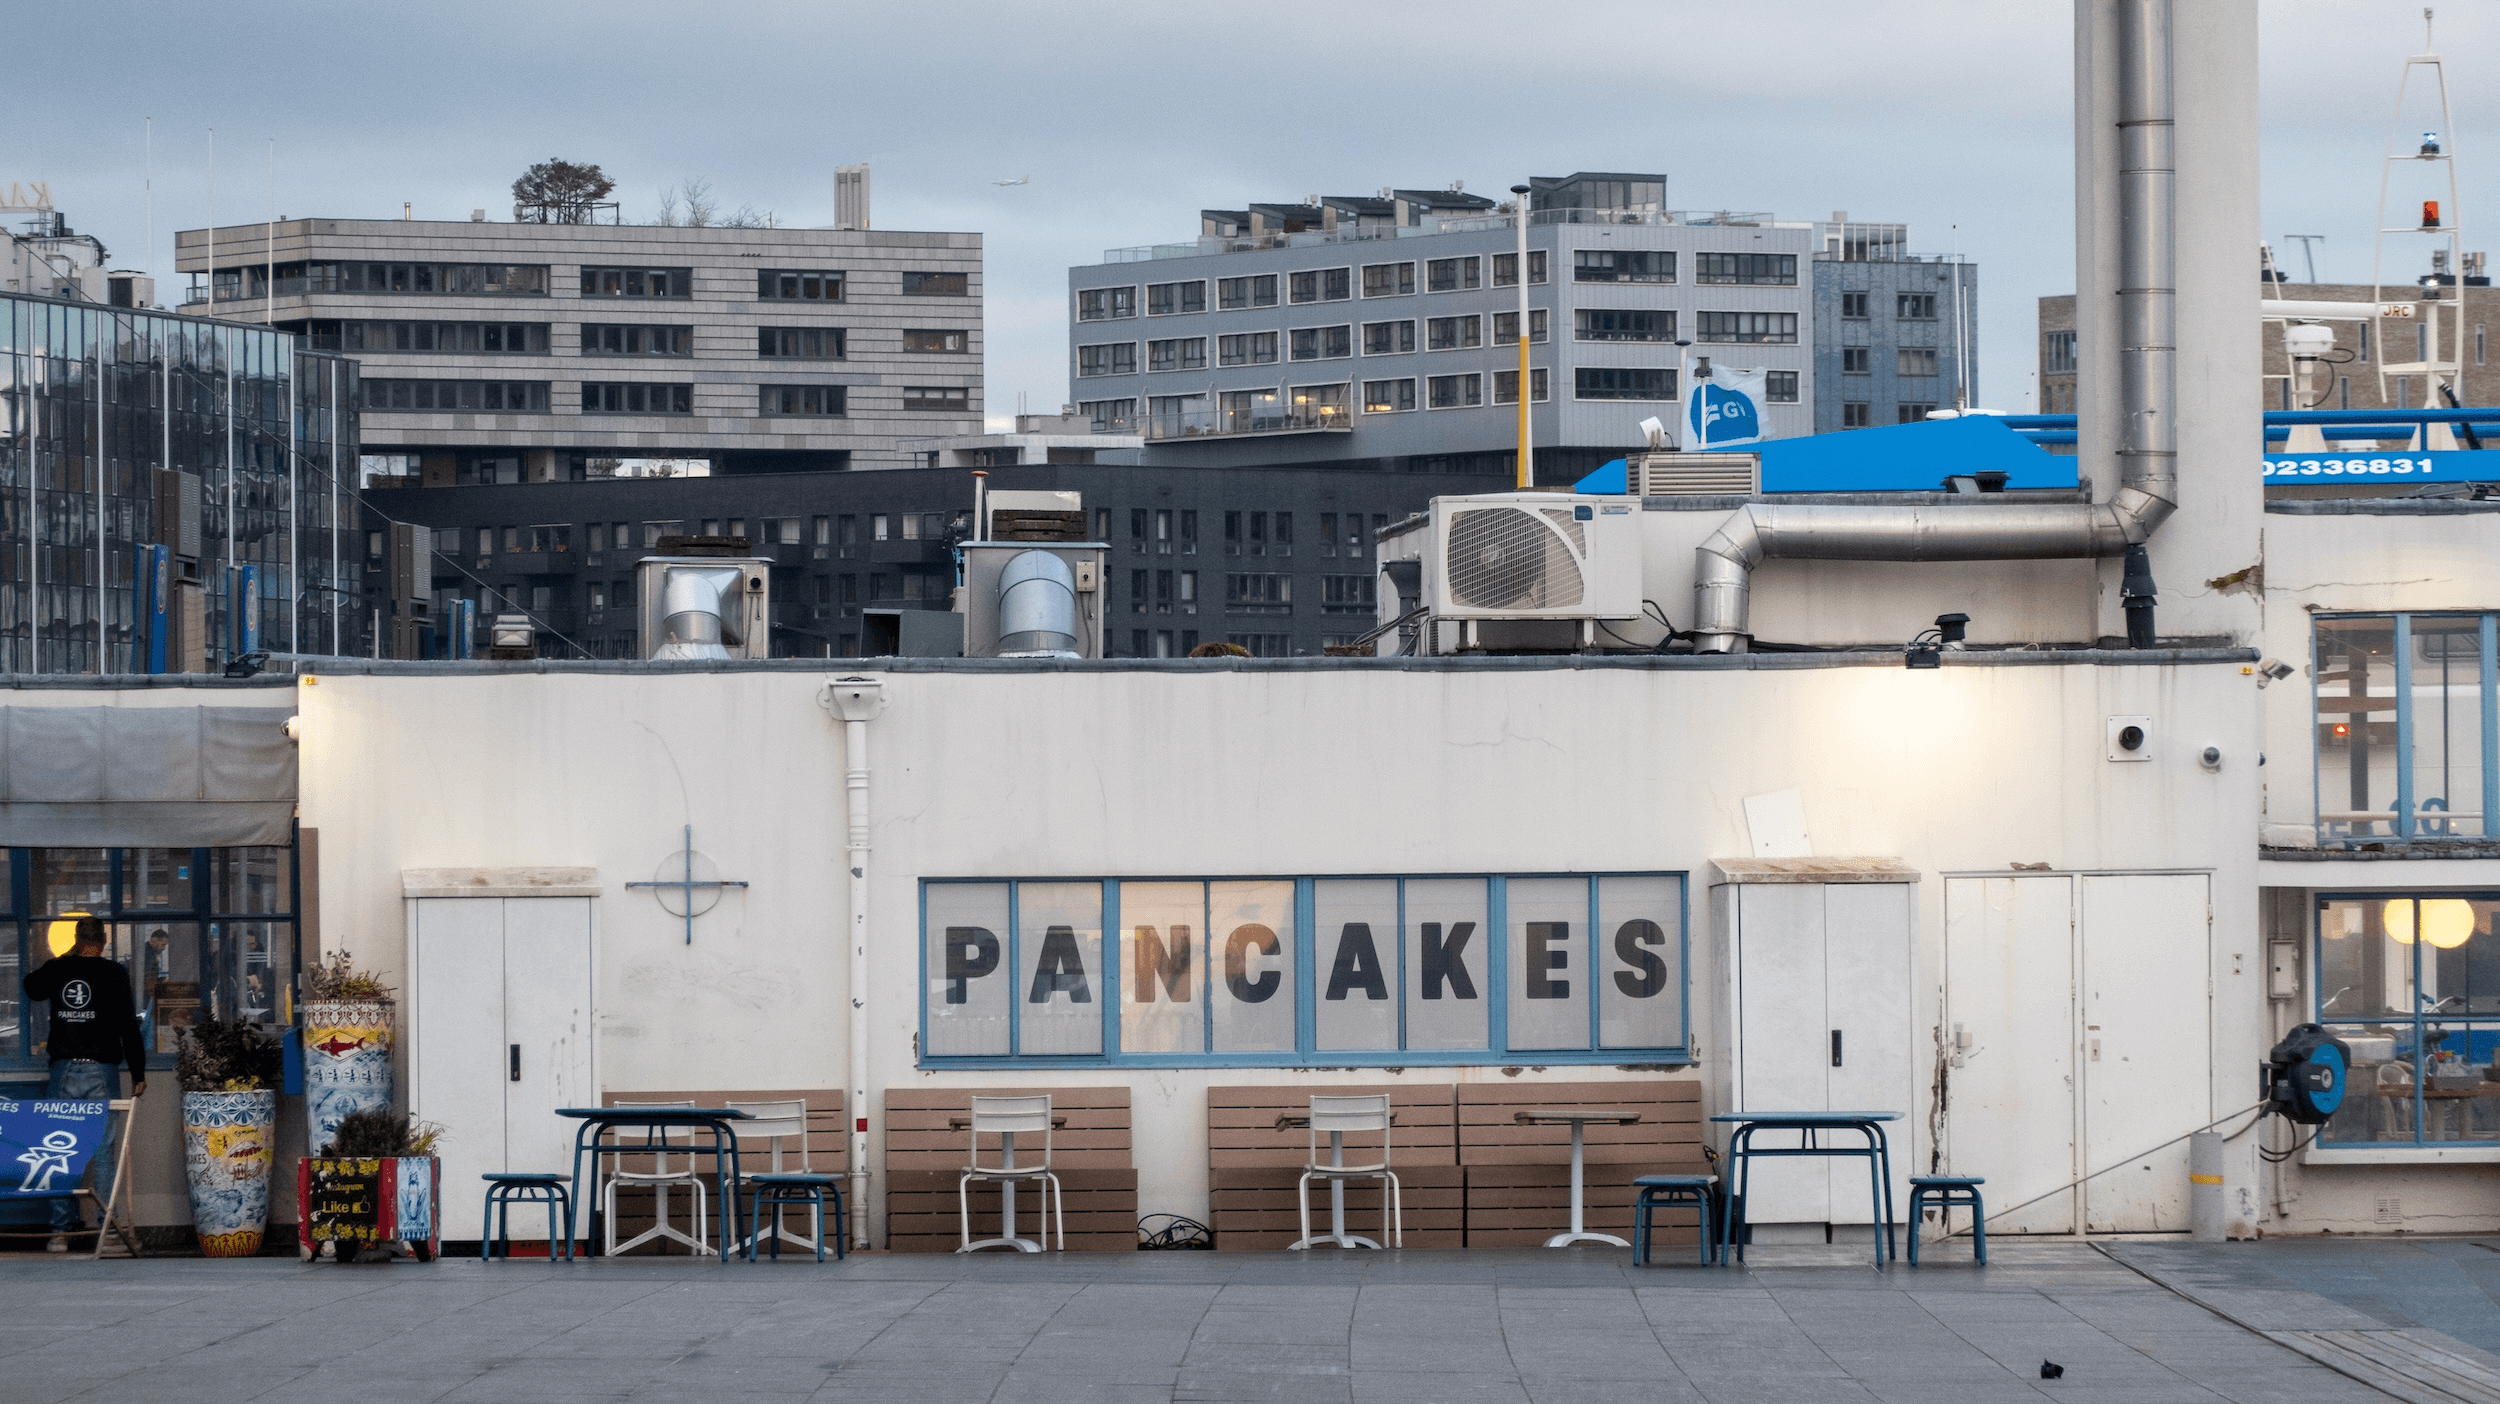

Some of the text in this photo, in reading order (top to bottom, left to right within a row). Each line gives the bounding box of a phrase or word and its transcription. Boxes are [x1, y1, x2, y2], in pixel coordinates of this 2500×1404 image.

[2383, 305, 2410, 317] JRC
[946, 918, 1668, 1004] PANCAKES
[57, 1010, 96, 1019] PANCAKES
[33, 1102, 104, 1115] PANCAKES
[322, 1200, 350, 1214] Like
